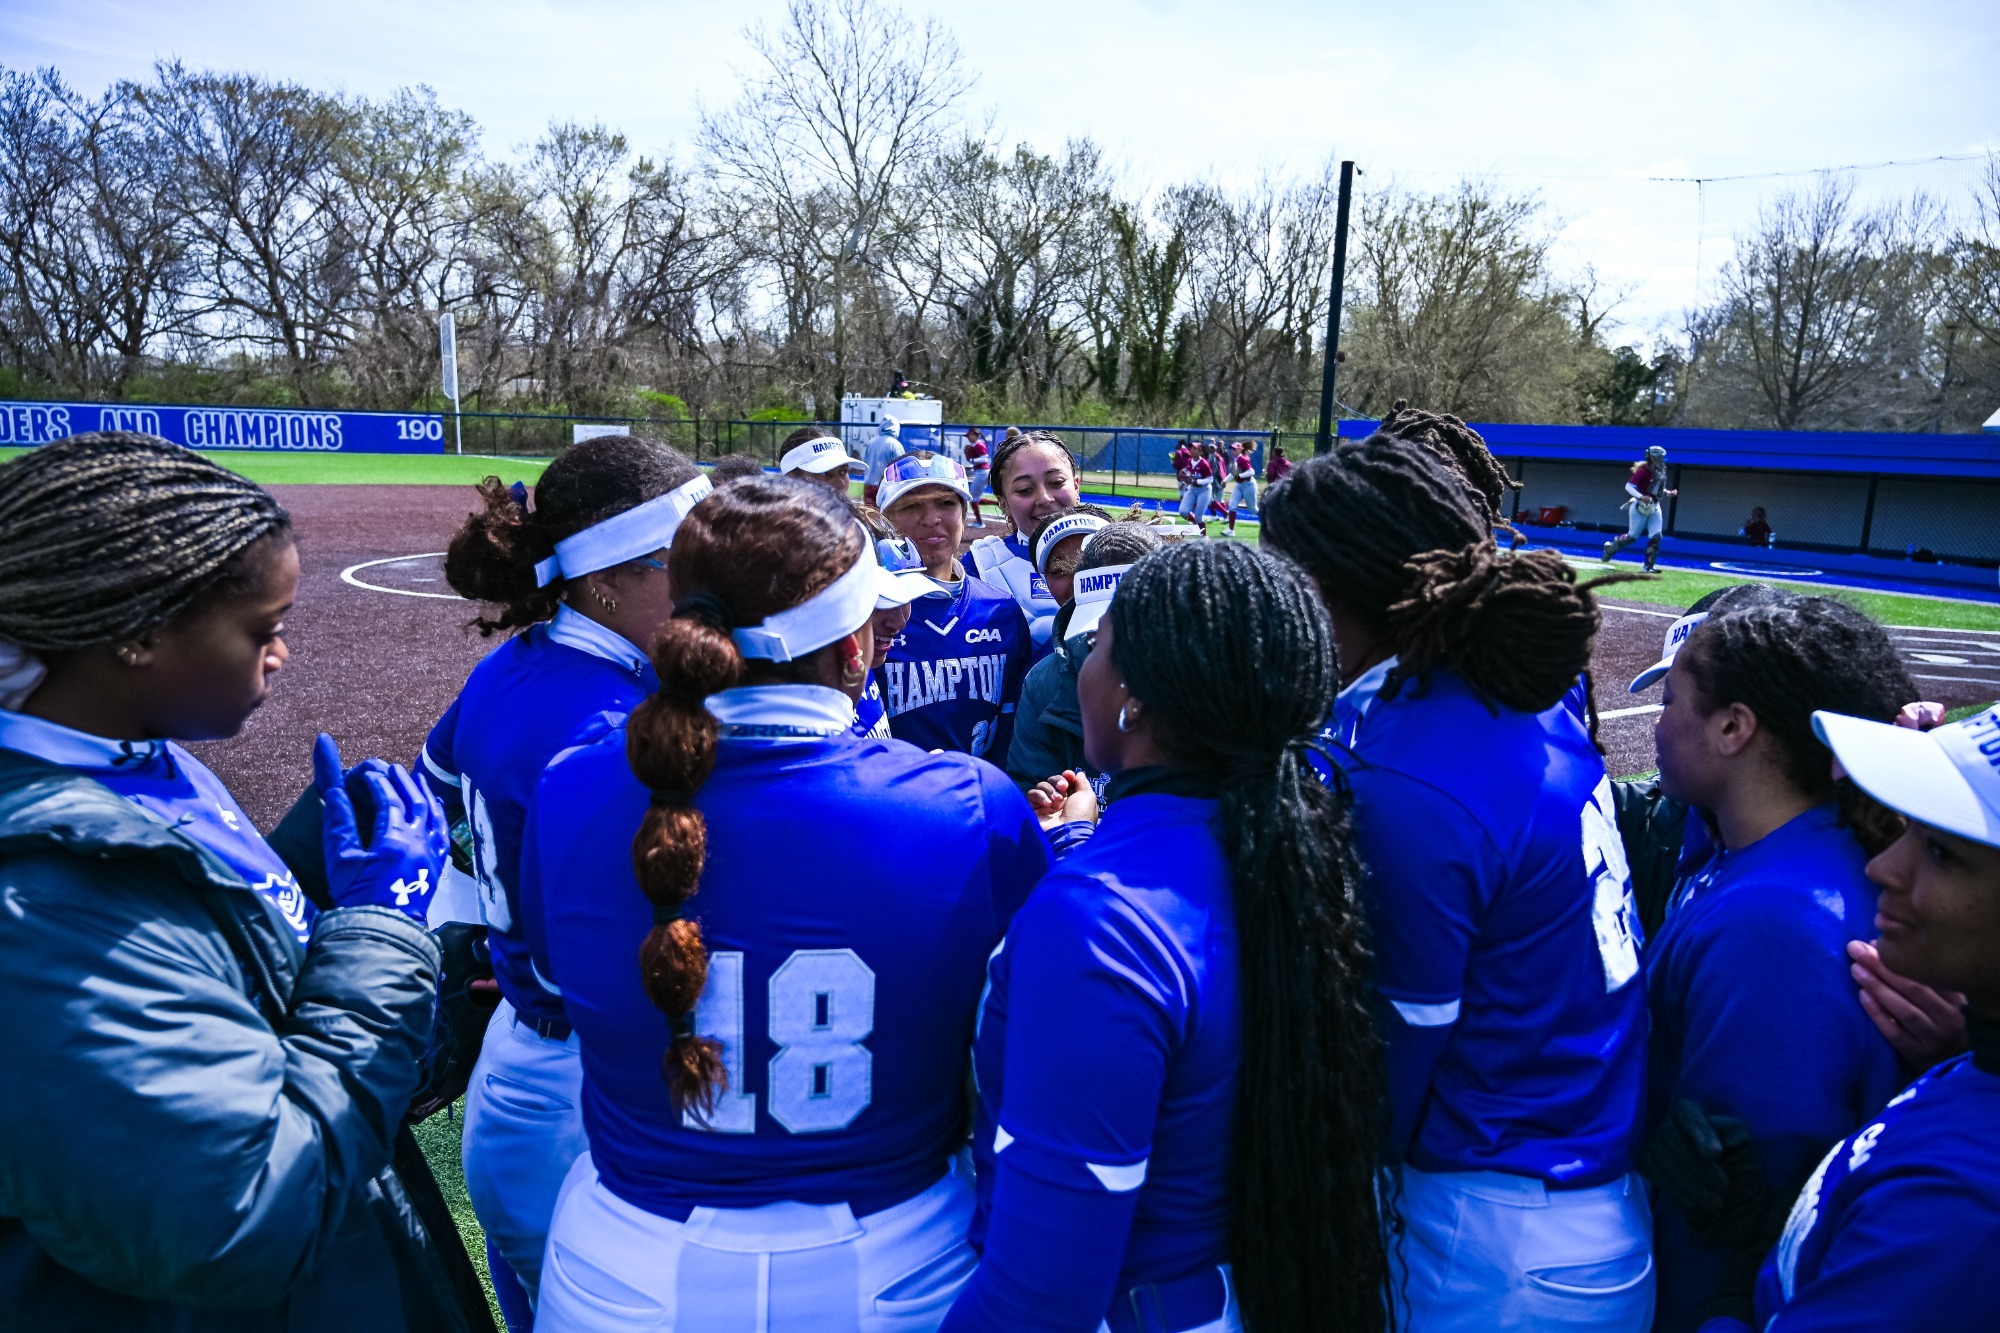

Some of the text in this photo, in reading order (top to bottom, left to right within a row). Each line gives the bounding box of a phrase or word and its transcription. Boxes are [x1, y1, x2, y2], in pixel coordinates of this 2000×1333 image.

[184, 411, 343, 450] CHAMPIONS
[397, 419, 442, 440] 190
[1042, 517, 1097, 544] HAMPTON
[1079, 572, 1126, 594] HAMPT
[965, 628, 1002, 644] CAA
[885, 653, 1007, 719] HAMPTON
[682, 948, 876, 1134] 18
